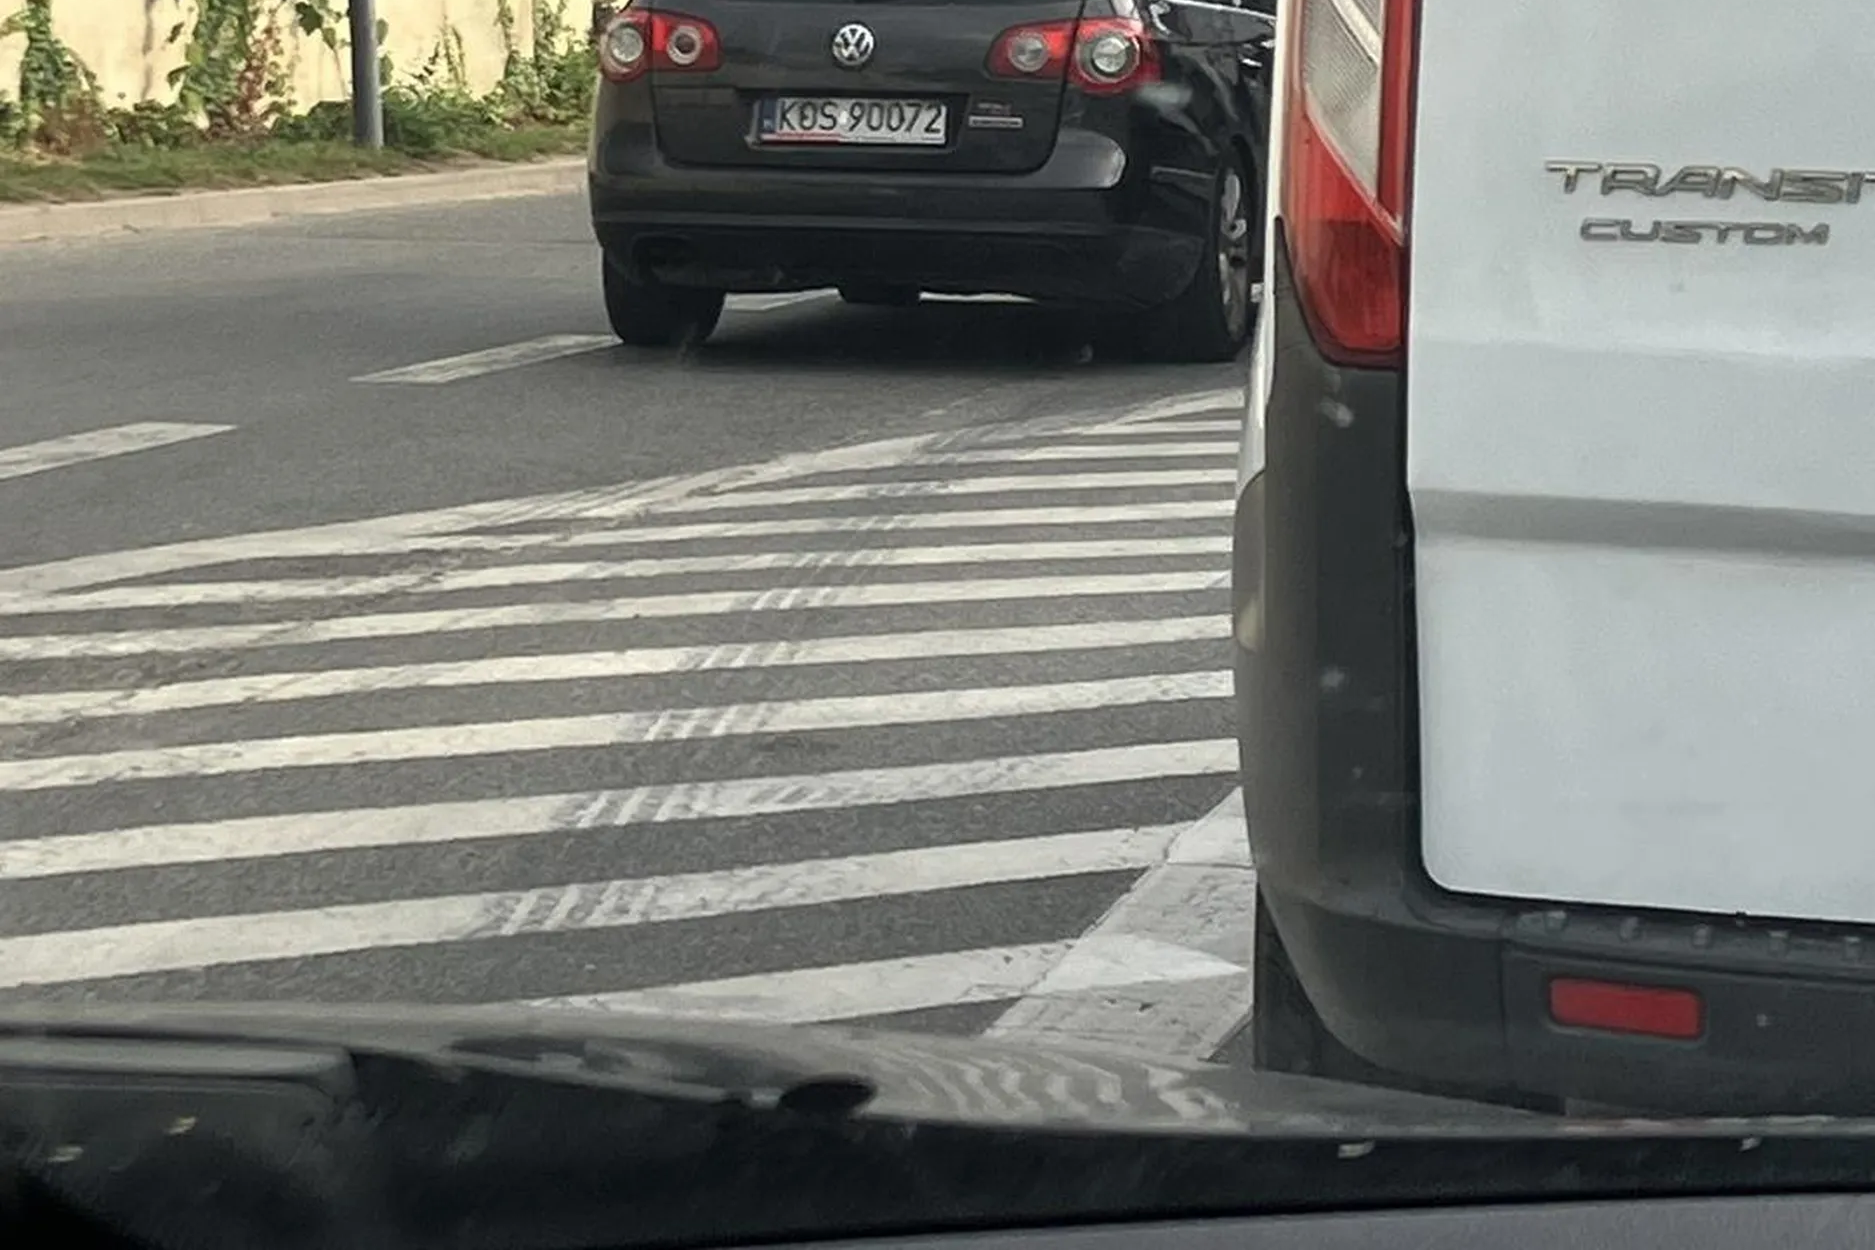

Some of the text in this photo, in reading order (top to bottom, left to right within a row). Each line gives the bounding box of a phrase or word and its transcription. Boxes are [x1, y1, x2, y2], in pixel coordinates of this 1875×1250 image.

[847, 101, 942, 133] 90072
[1545, 160, 1875, 204] TRANSI
[1580, 217, 1830, 246] CUSTOM
